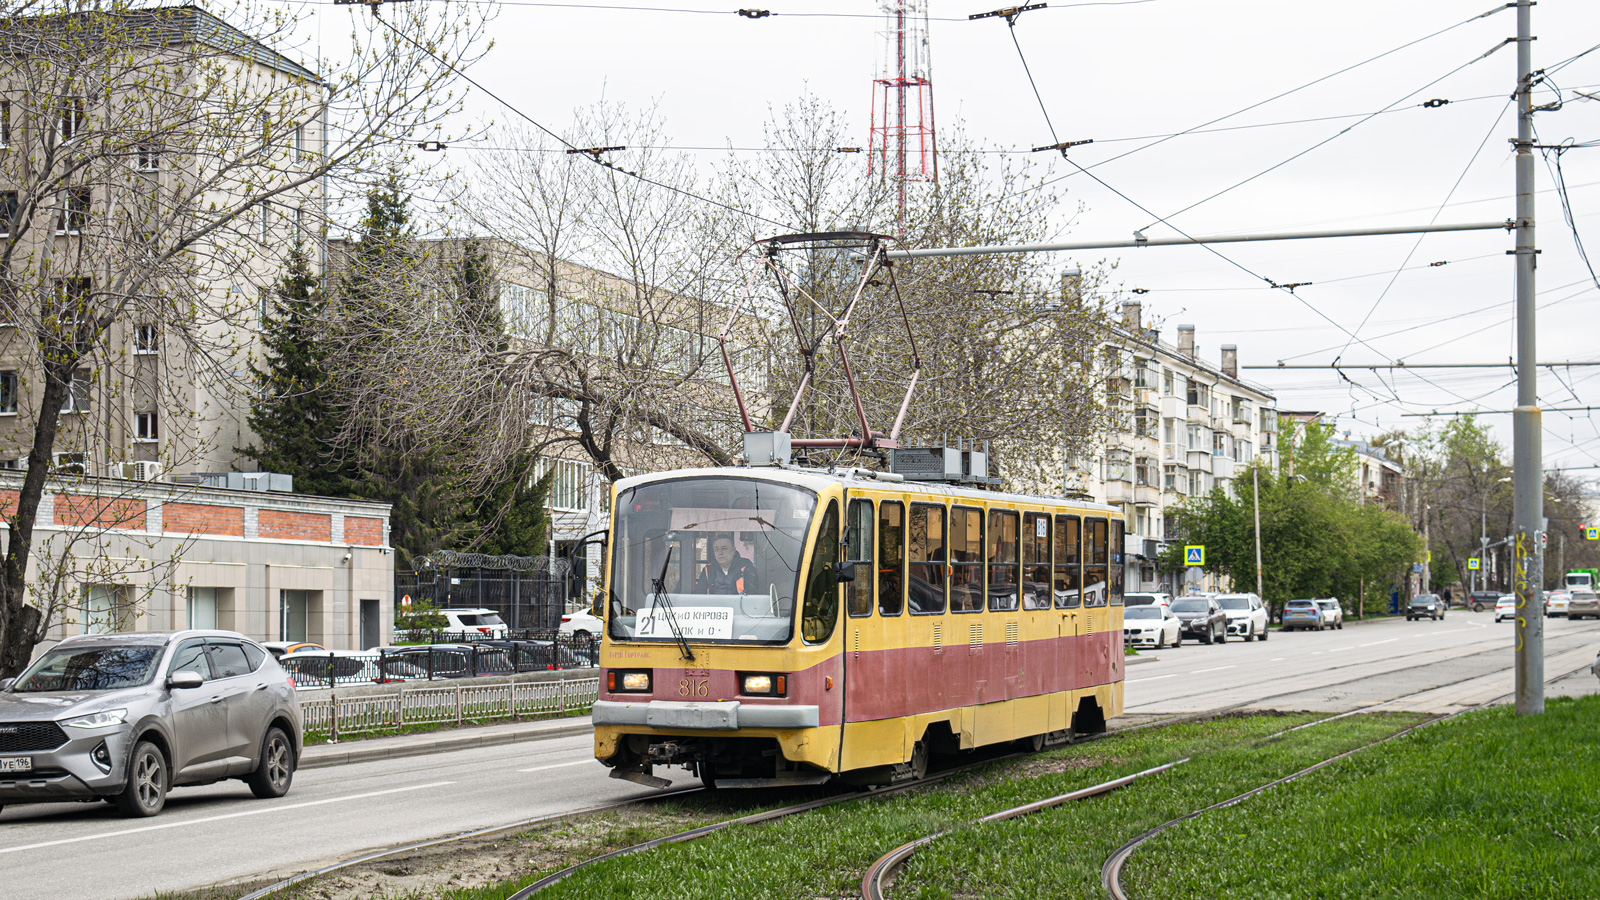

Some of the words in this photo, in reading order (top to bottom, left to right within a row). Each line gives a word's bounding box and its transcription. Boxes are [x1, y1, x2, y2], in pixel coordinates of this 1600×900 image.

[640, 616, 656, 635] 21
[679, 679, 709, 697] 816
[15, 758, 29, 767] 196
